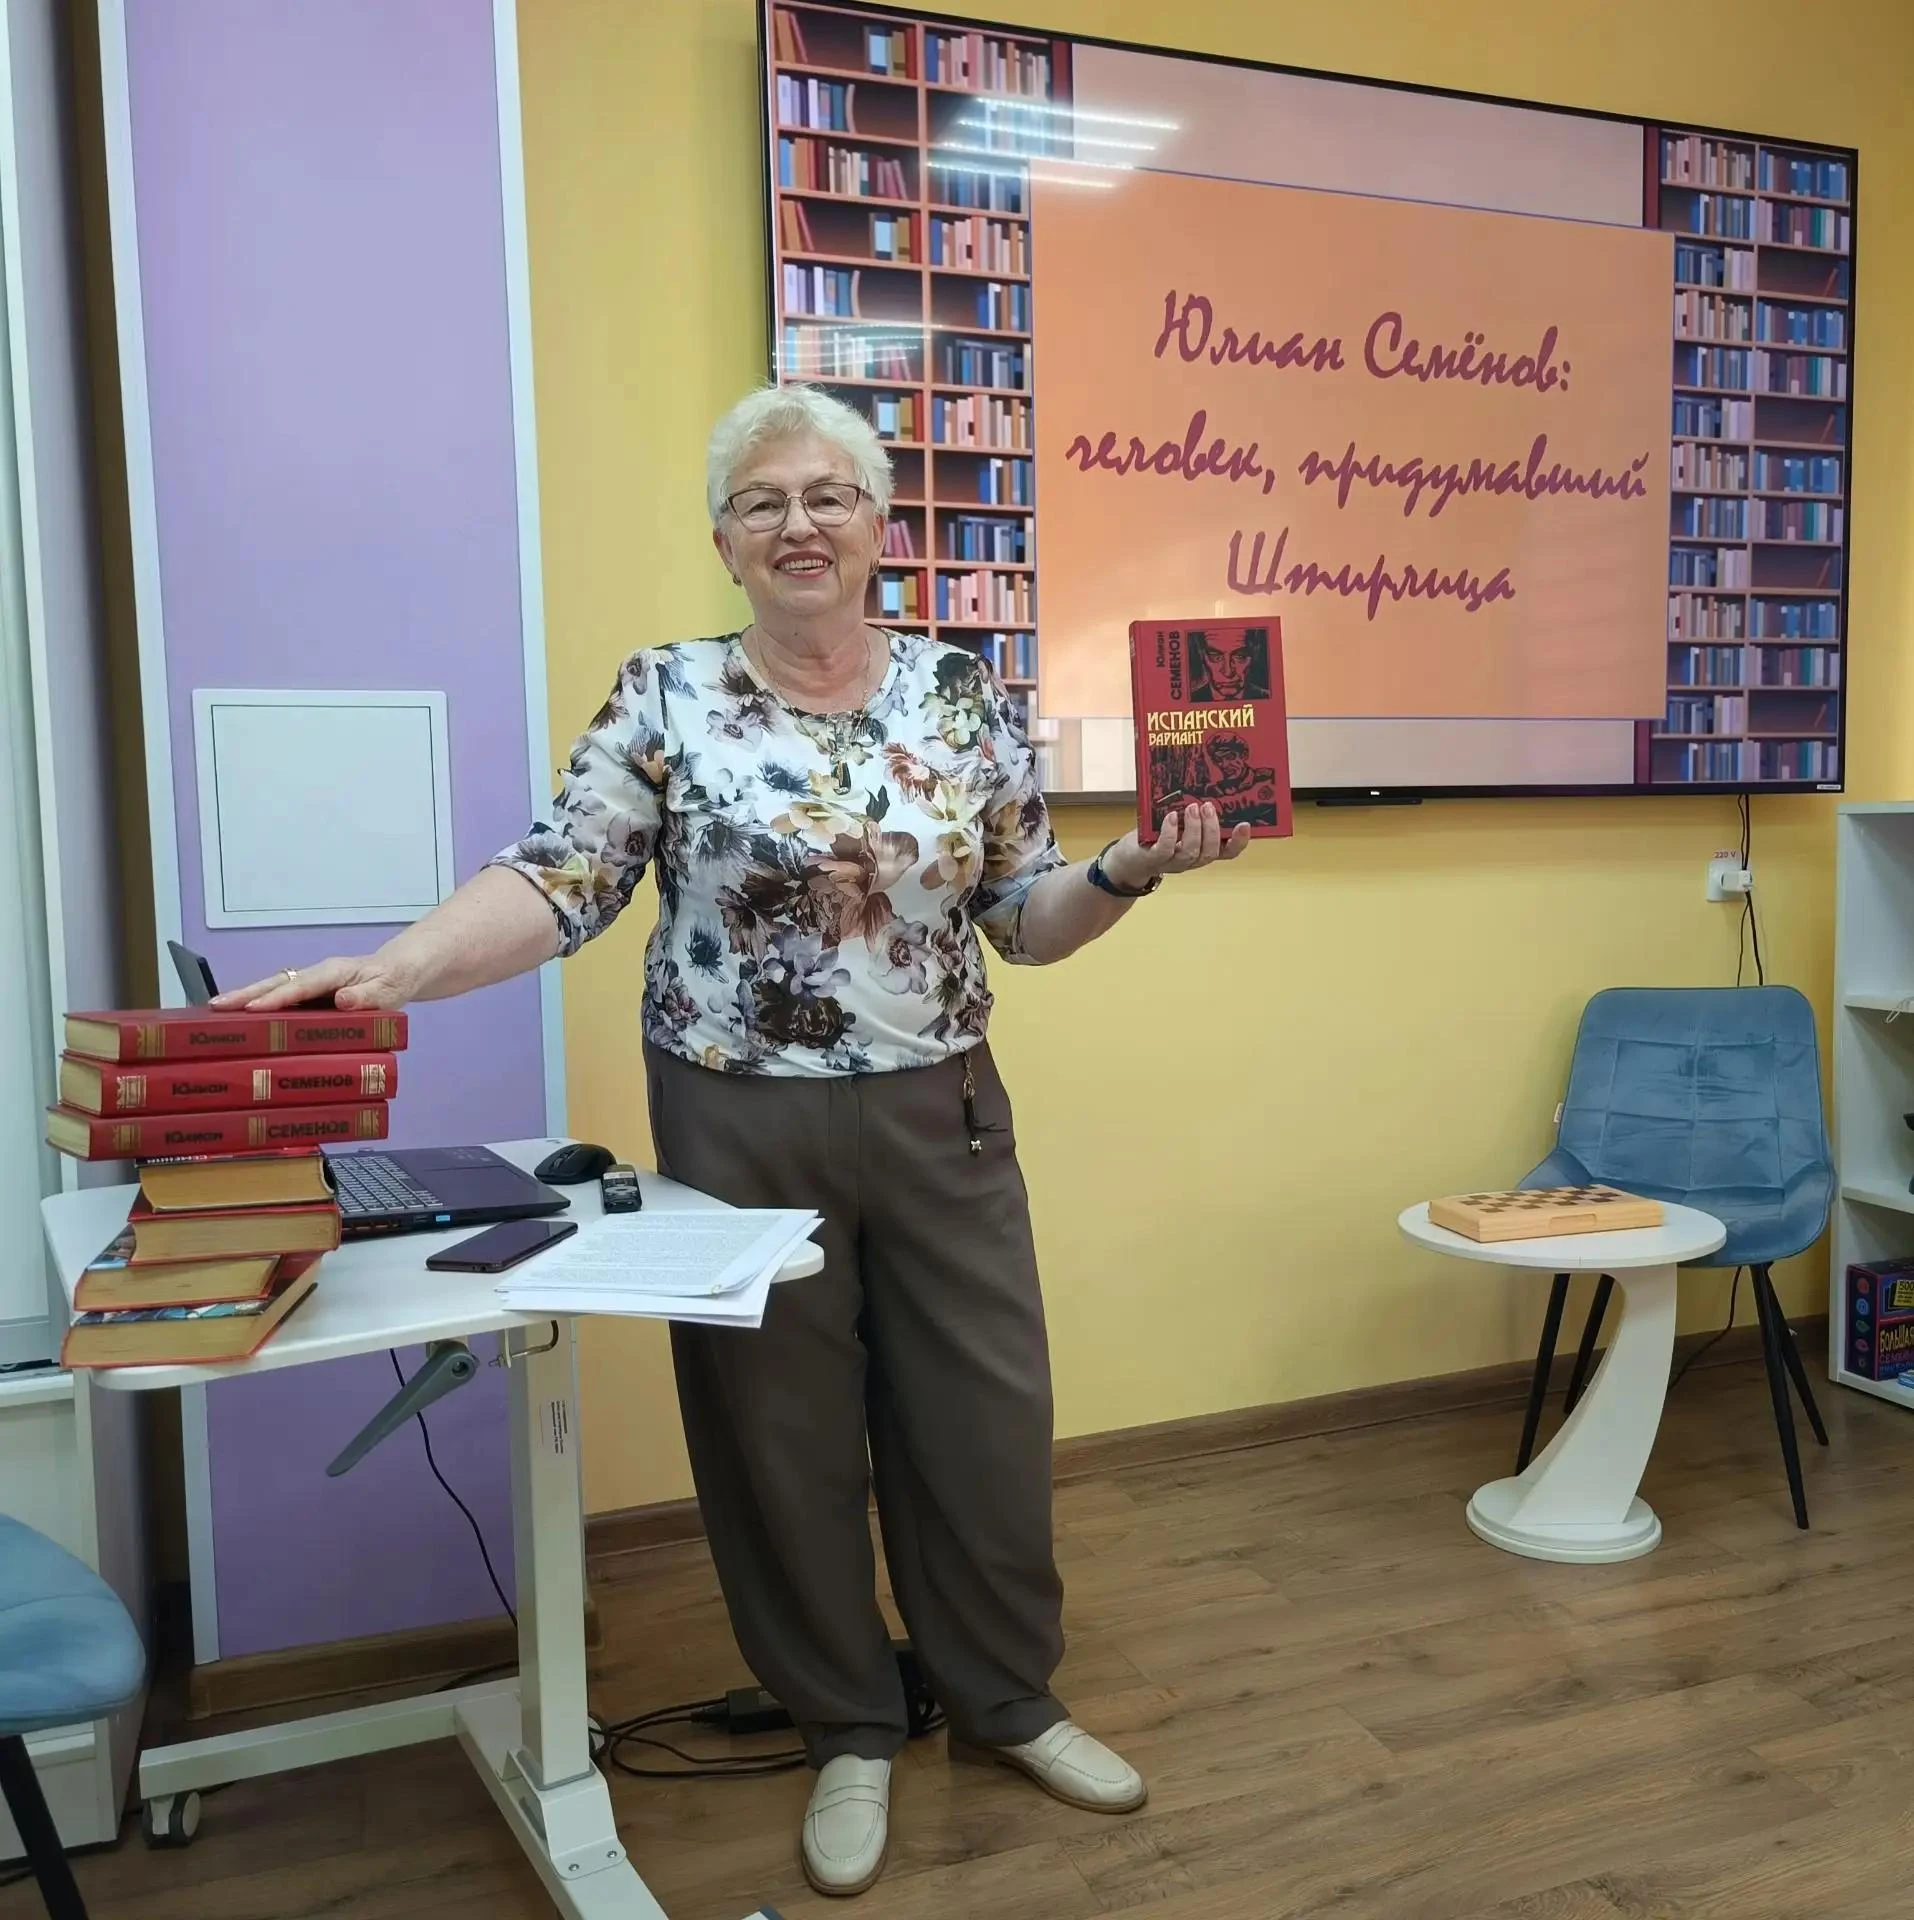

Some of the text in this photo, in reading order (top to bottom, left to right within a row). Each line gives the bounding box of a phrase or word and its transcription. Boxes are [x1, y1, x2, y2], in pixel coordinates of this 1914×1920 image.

[1154, 289, 1571, 393] Юлиан Семёнов:
[1065, 409, 1650, 518] человек, придумавший
[1226, 526, 1515, 621] Штирлица
[1156, 631, 1166, 668] Юлиан
[1168, 630, 1182, 701] СЕМЕНОВ
[1147, 704, 1255, 731] ИСПАНСКИЙ
[1148, 730, 1204, 746] ВАРИАНТ
[189, 1027, 366, 1046] Юлиан СЕМЕНОВ
[172, 1075, 354, 1096] Юлиан СЕМЕНОВ
[164, 1120, 350, 1145] Юлиан СЕМЕНОВ
